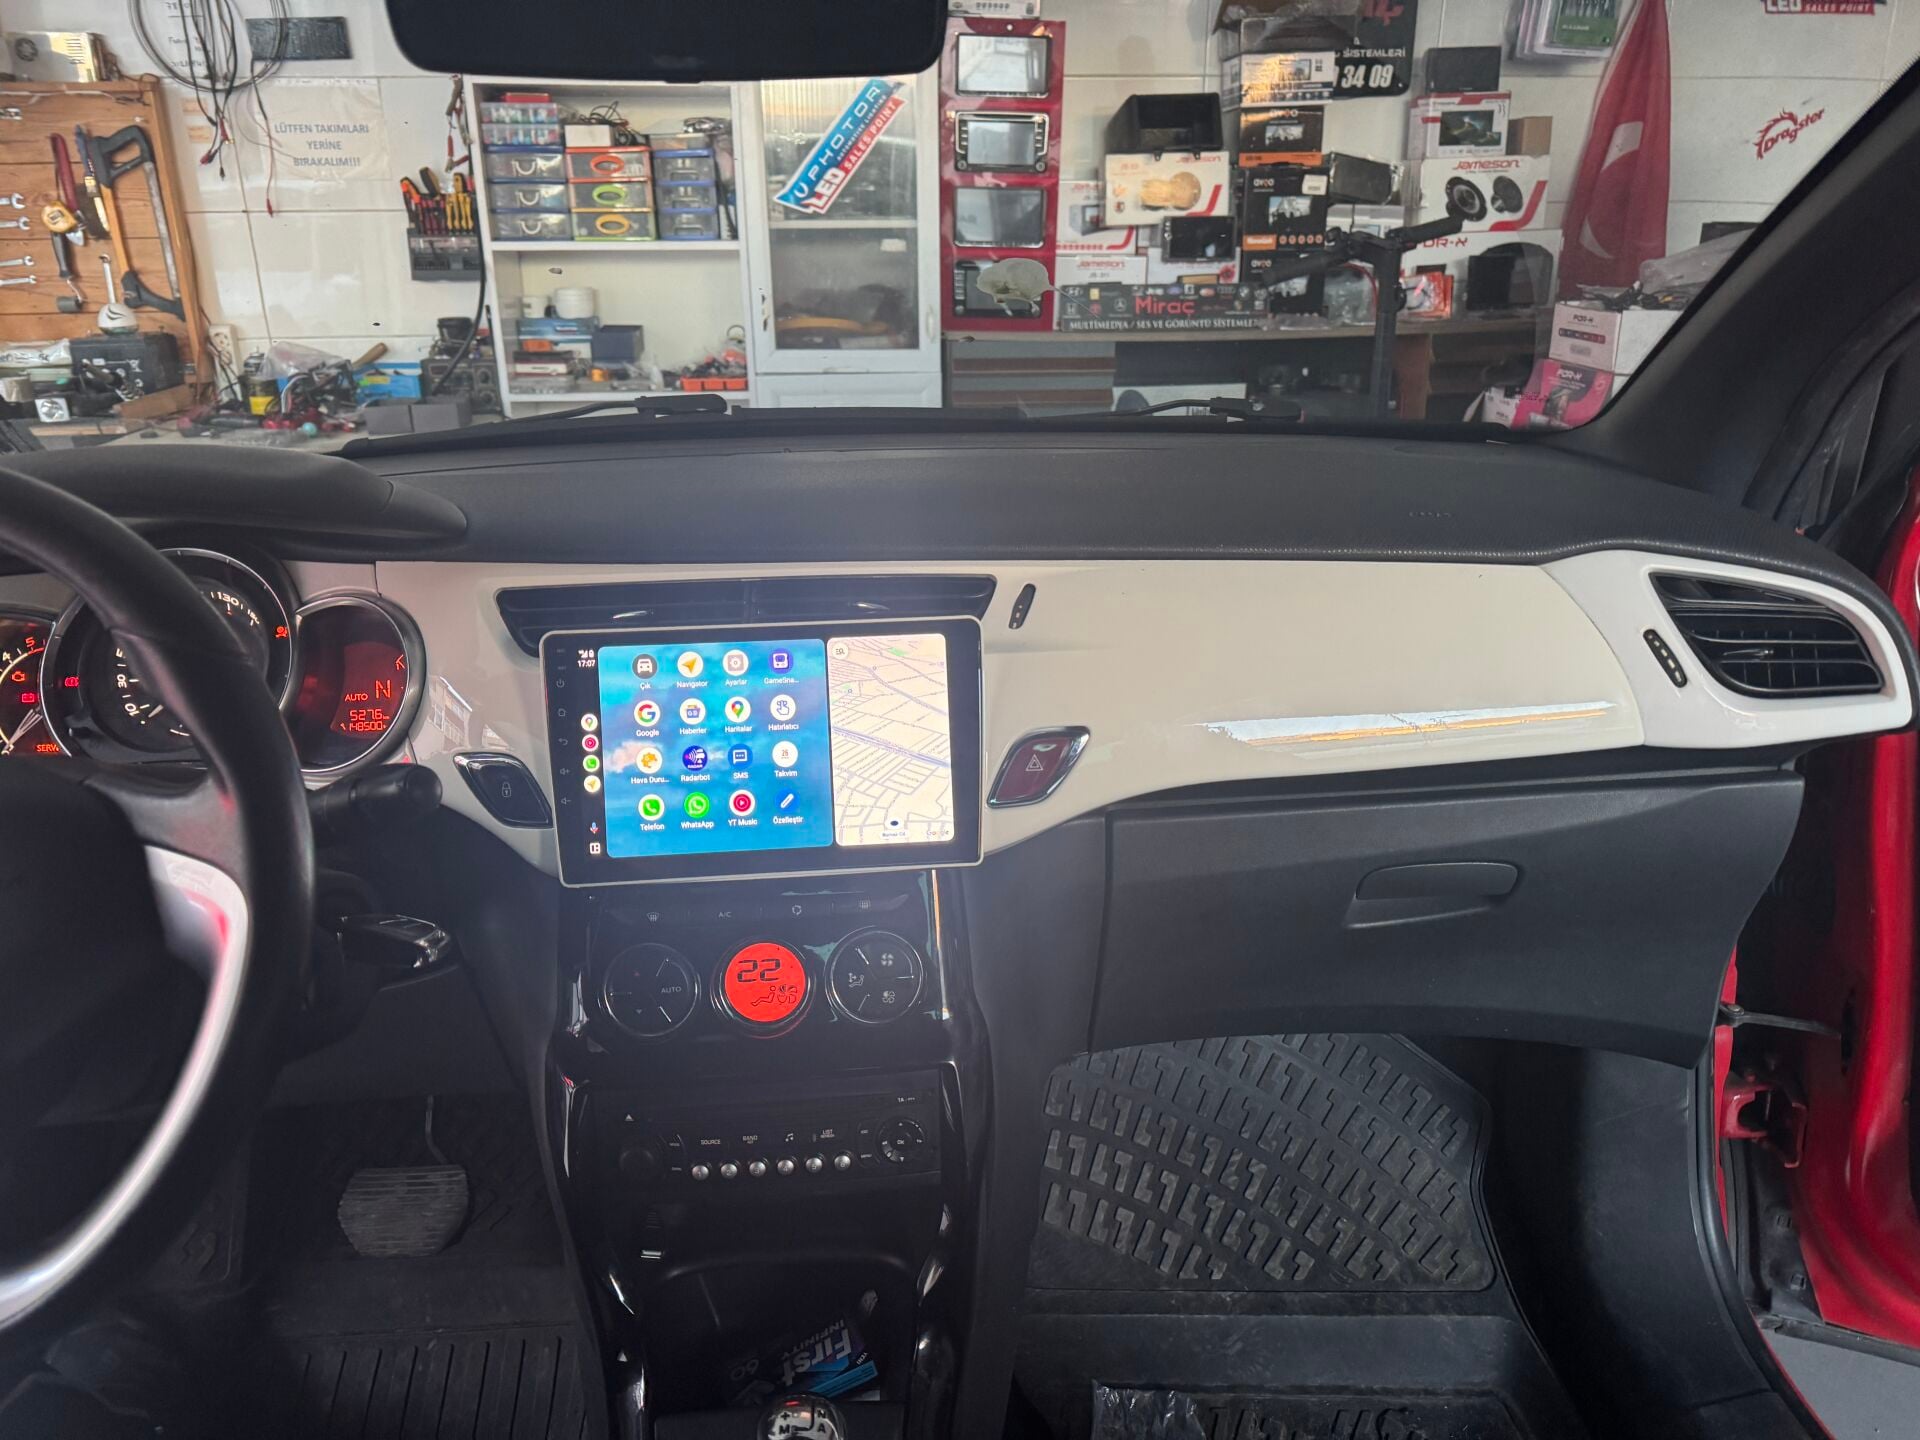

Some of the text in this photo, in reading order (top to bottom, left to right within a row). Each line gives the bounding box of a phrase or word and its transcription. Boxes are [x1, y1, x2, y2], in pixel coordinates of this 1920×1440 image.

[1804, 3, 1836, 12] SALES
[1839, 3, 1871, 12] POINT
[1341, 64, 1394, 88] 34 09
[274, 121, 369, 134] LÜTFEN TAKIMLARI
[1762, 107, 1825, 153] Dragster
[305, 139, 342, 150] YERİNE
[811, 103, 896, 207] LED SALES POINT
[1421, 237, 1468, 248] OR-X
[1134, 295, 1196, 317] Miraç
[1152, 319, 1165, 328] VE
[217, 591, 240, 606] 130
[25, 637, 36, 648] 5
[2, 651, 11, 661] 4
[577, 659, 596, 668] 17:07
[116, 673, 128, 688] 30
[724, 679, 747, 687] Ayarlar
[344, 693, 369, 702] AUTO
[124, 703, 140, 716] 10
[724, 725, 753, 733] Haritalar
[768, 724, 799, 732] Hatırlatıcı
[635, 729, 660, 738] Google
[680, 773, 711, 782] Radarbot
[733, 771, 749, 779] SMS
[774, 769, 798, 778] Takvim
[727, 818, 758, 827] YT Music
[772, 815, 804, 824] Özelleştir
[639, 822, 665, 831] Telefon
[680, 820, 715, 830] WhatsApp
[737, 958, 781, 983] 22
[661, 986, 682, 994] AUTO
[778, 1328, 852, 1387] First
[779, 1424, 790, 1434] M
[817, 1423, 826, 1433] A
